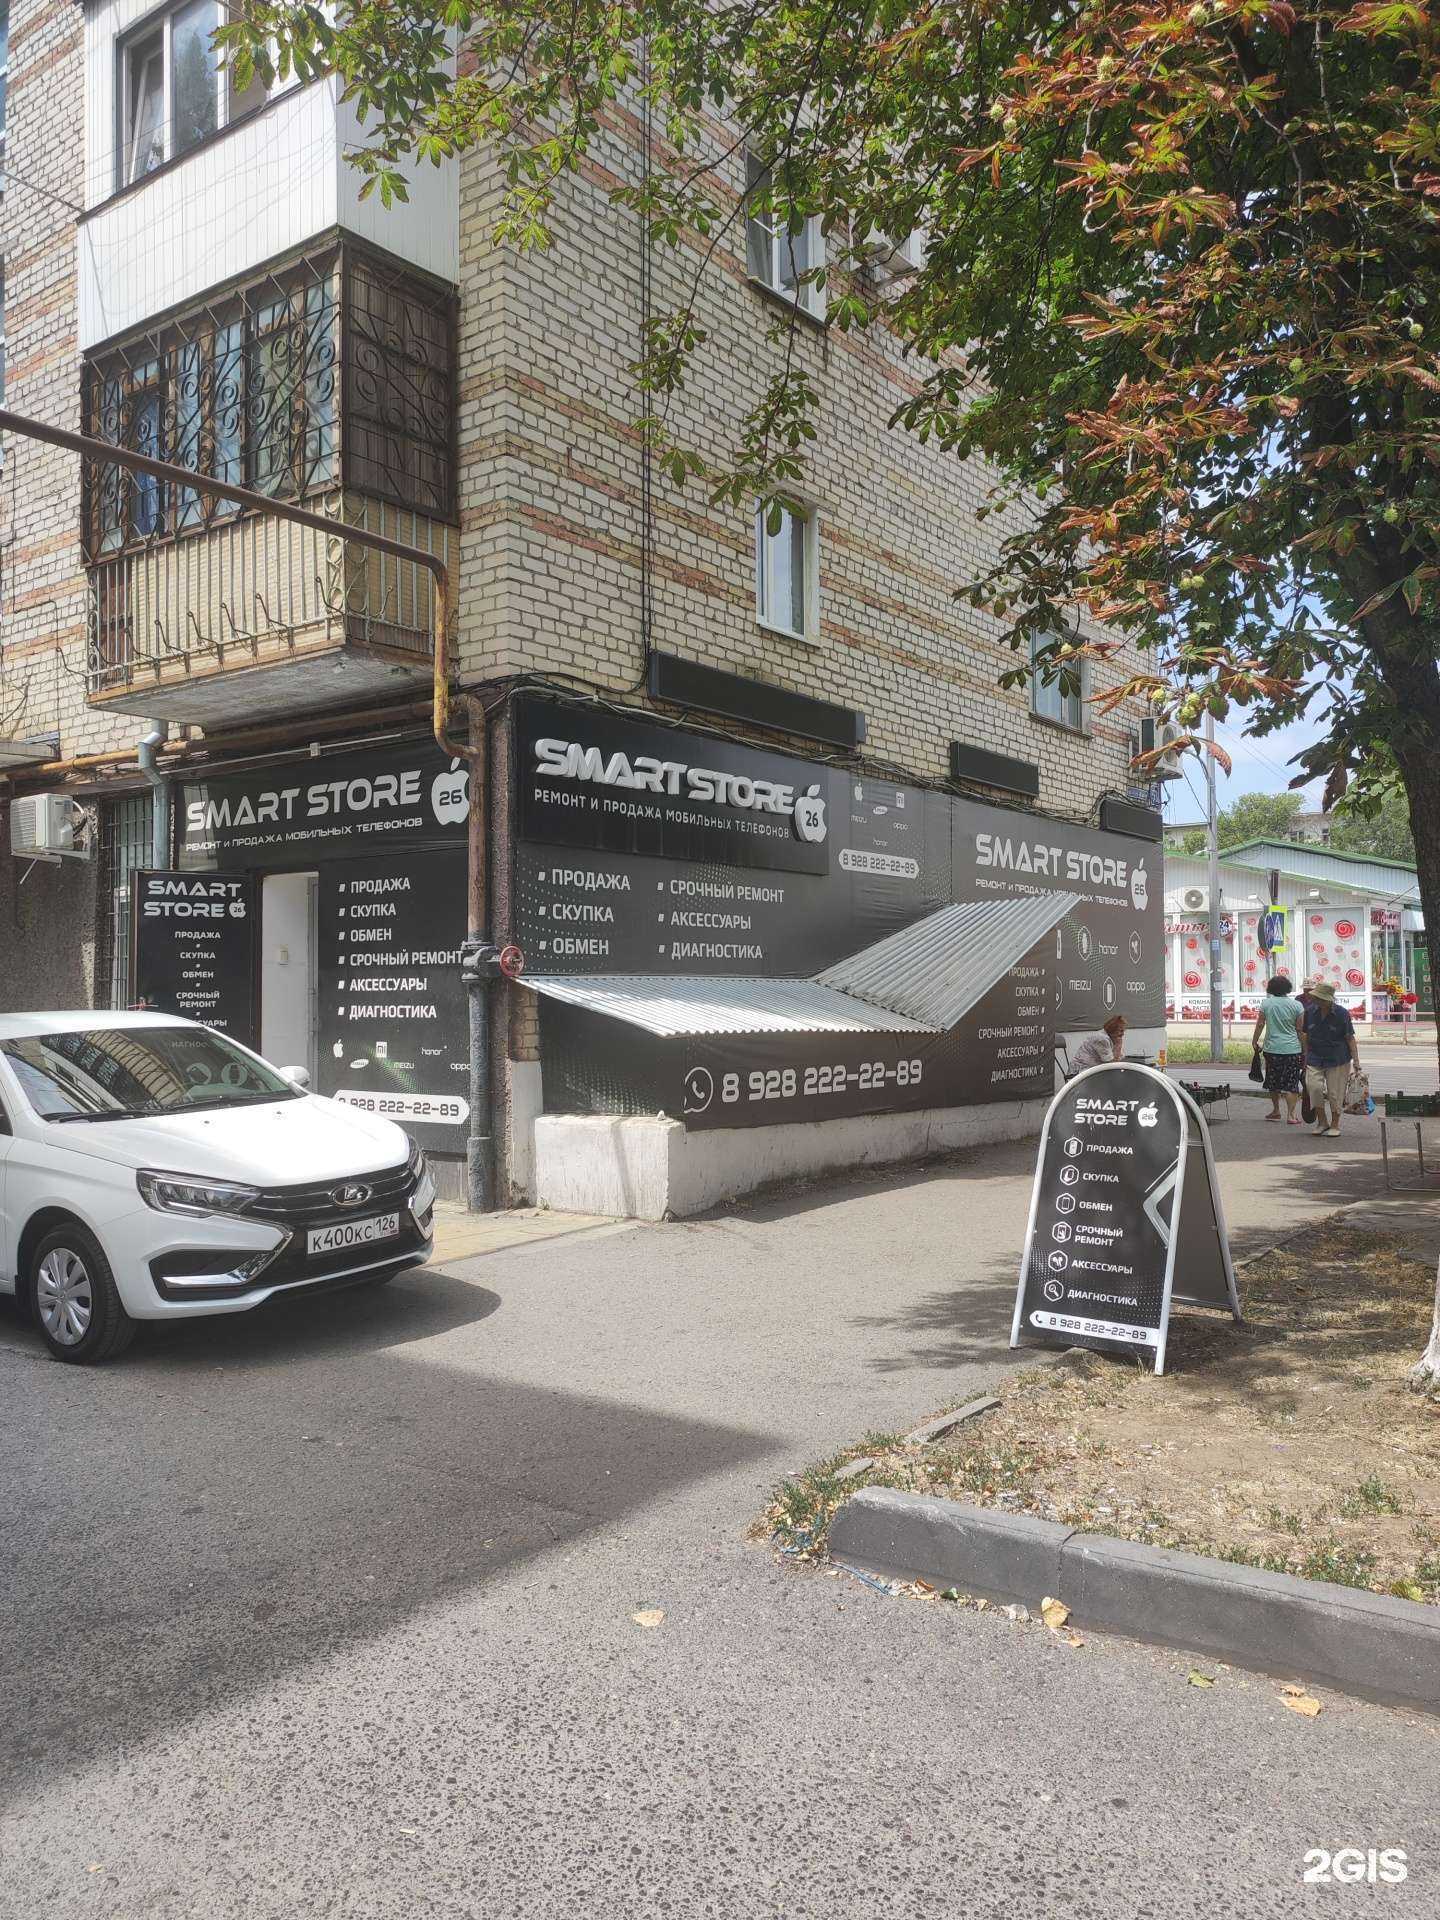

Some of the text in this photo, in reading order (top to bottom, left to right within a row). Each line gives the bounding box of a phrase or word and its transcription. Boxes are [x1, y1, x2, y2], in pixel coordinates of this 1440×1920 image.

[534, 738, 797, 815] SMART STORE
[186, 769, 422, 832] SMART STORE
[439, 788, 463, 806] 26
[534, 789, 790, 839] РЕМОНТ И ПРОДАЖА МОБИЛЬНЫХ ТЕЛЕФОНОВ
[806, 810, 819, 828] 26
[186, 817, 423, 852] РЕМОНТ И ПРОДАЖА МОБИЛЬНЫХ ТЕЛЕФОНОВ
[843, 853, 916, 874] 8 928 222-22-89
[975, 833, 1128, 889] SMART STORE
[350, 877, 411, 895] ПРОДАЖА
[552, 868, 631, 892] ПРОДАЖА
[975, 878, 1007, 890] РЕМОНТ
[1014, 884, 1051, 897] ПРОДАЖА
[147, 880, 242, 898] SMART
[670, 879, 784, 904] СРОЧНЫЙ РЕМОНТ
[1134, 883, 1145, 896] 26
[143, 902, 225, 918] STORE
[350, 902, 397, 918] СКУПКА
[552, 903, 614, 922] СКУПКА
[671, 911, 751, 930] АКСЕССУАРЫ
[174, 931, 221, 940] ПРОДАЖА
[350, 929, 392, 943] ОБМЕН
[552, 937, 609, 955] ОБМЕН
[671, 942, 763, 960] ДИАГНОСТИКА
[180, 951, 216, 960] СКУПКА
[350, 949, 463, 967] СРОЧНЫЙ РЕМОНТ
[182, 971, 214, 979] ОБМЕН
[1008, 967, 1039, 978] ПРОДАЖА
[349, 978, 428, 992] АКСЕССУАРЫ
[1015, 986, 1039, 997] СКУПКА
[176, 990, 220, 1000] СРОЧНЫЙ
[180, 1000, 217, 1008] РЕМОНТ
[1017, 1006, 1040, 1016] ОБМЕН
[349, 1005, 437, 1020] ДИАГНОСТИКА
[978, 1025, 1039, 1040] СРОЧНЫЙ РЕМОНТ
[997, 1046, 1039, 1059] АКСЕССУАРЫ
[721, 1059, 922, 1103] 8 928 222-22-89
[991, 1066, 1037, 1084] ДИАГНОСТИКА
[379, 1100, 459, 1117] 222-22-89
[1075, 1099, 1139, 1112] SMART
[1074, 1112, 1129, 1126] STORE
[1141, 1113, 1154, 1121] 26
[1086, 1143, 1133, 1155] ПРОДАЖА
[1082, 1172, 1119, 1183] СКУПКА
[1079, 1201, 1113, 1212] ОБМЕН
[376, 1216, 395, 1232] 126
[1076, 1224, 1124, 1237] СРОЧНЫЙ
[1075, 1235, 1114, 1247] РЕМОНТ
[1071, 1259, 1133, 1275] АКСЕССУАРЫ
[1067, 1289, 1138, 1307] ДИАГНОСТИКА
[1049, 1317, 1147, 1340] 8 928 222-22-89
